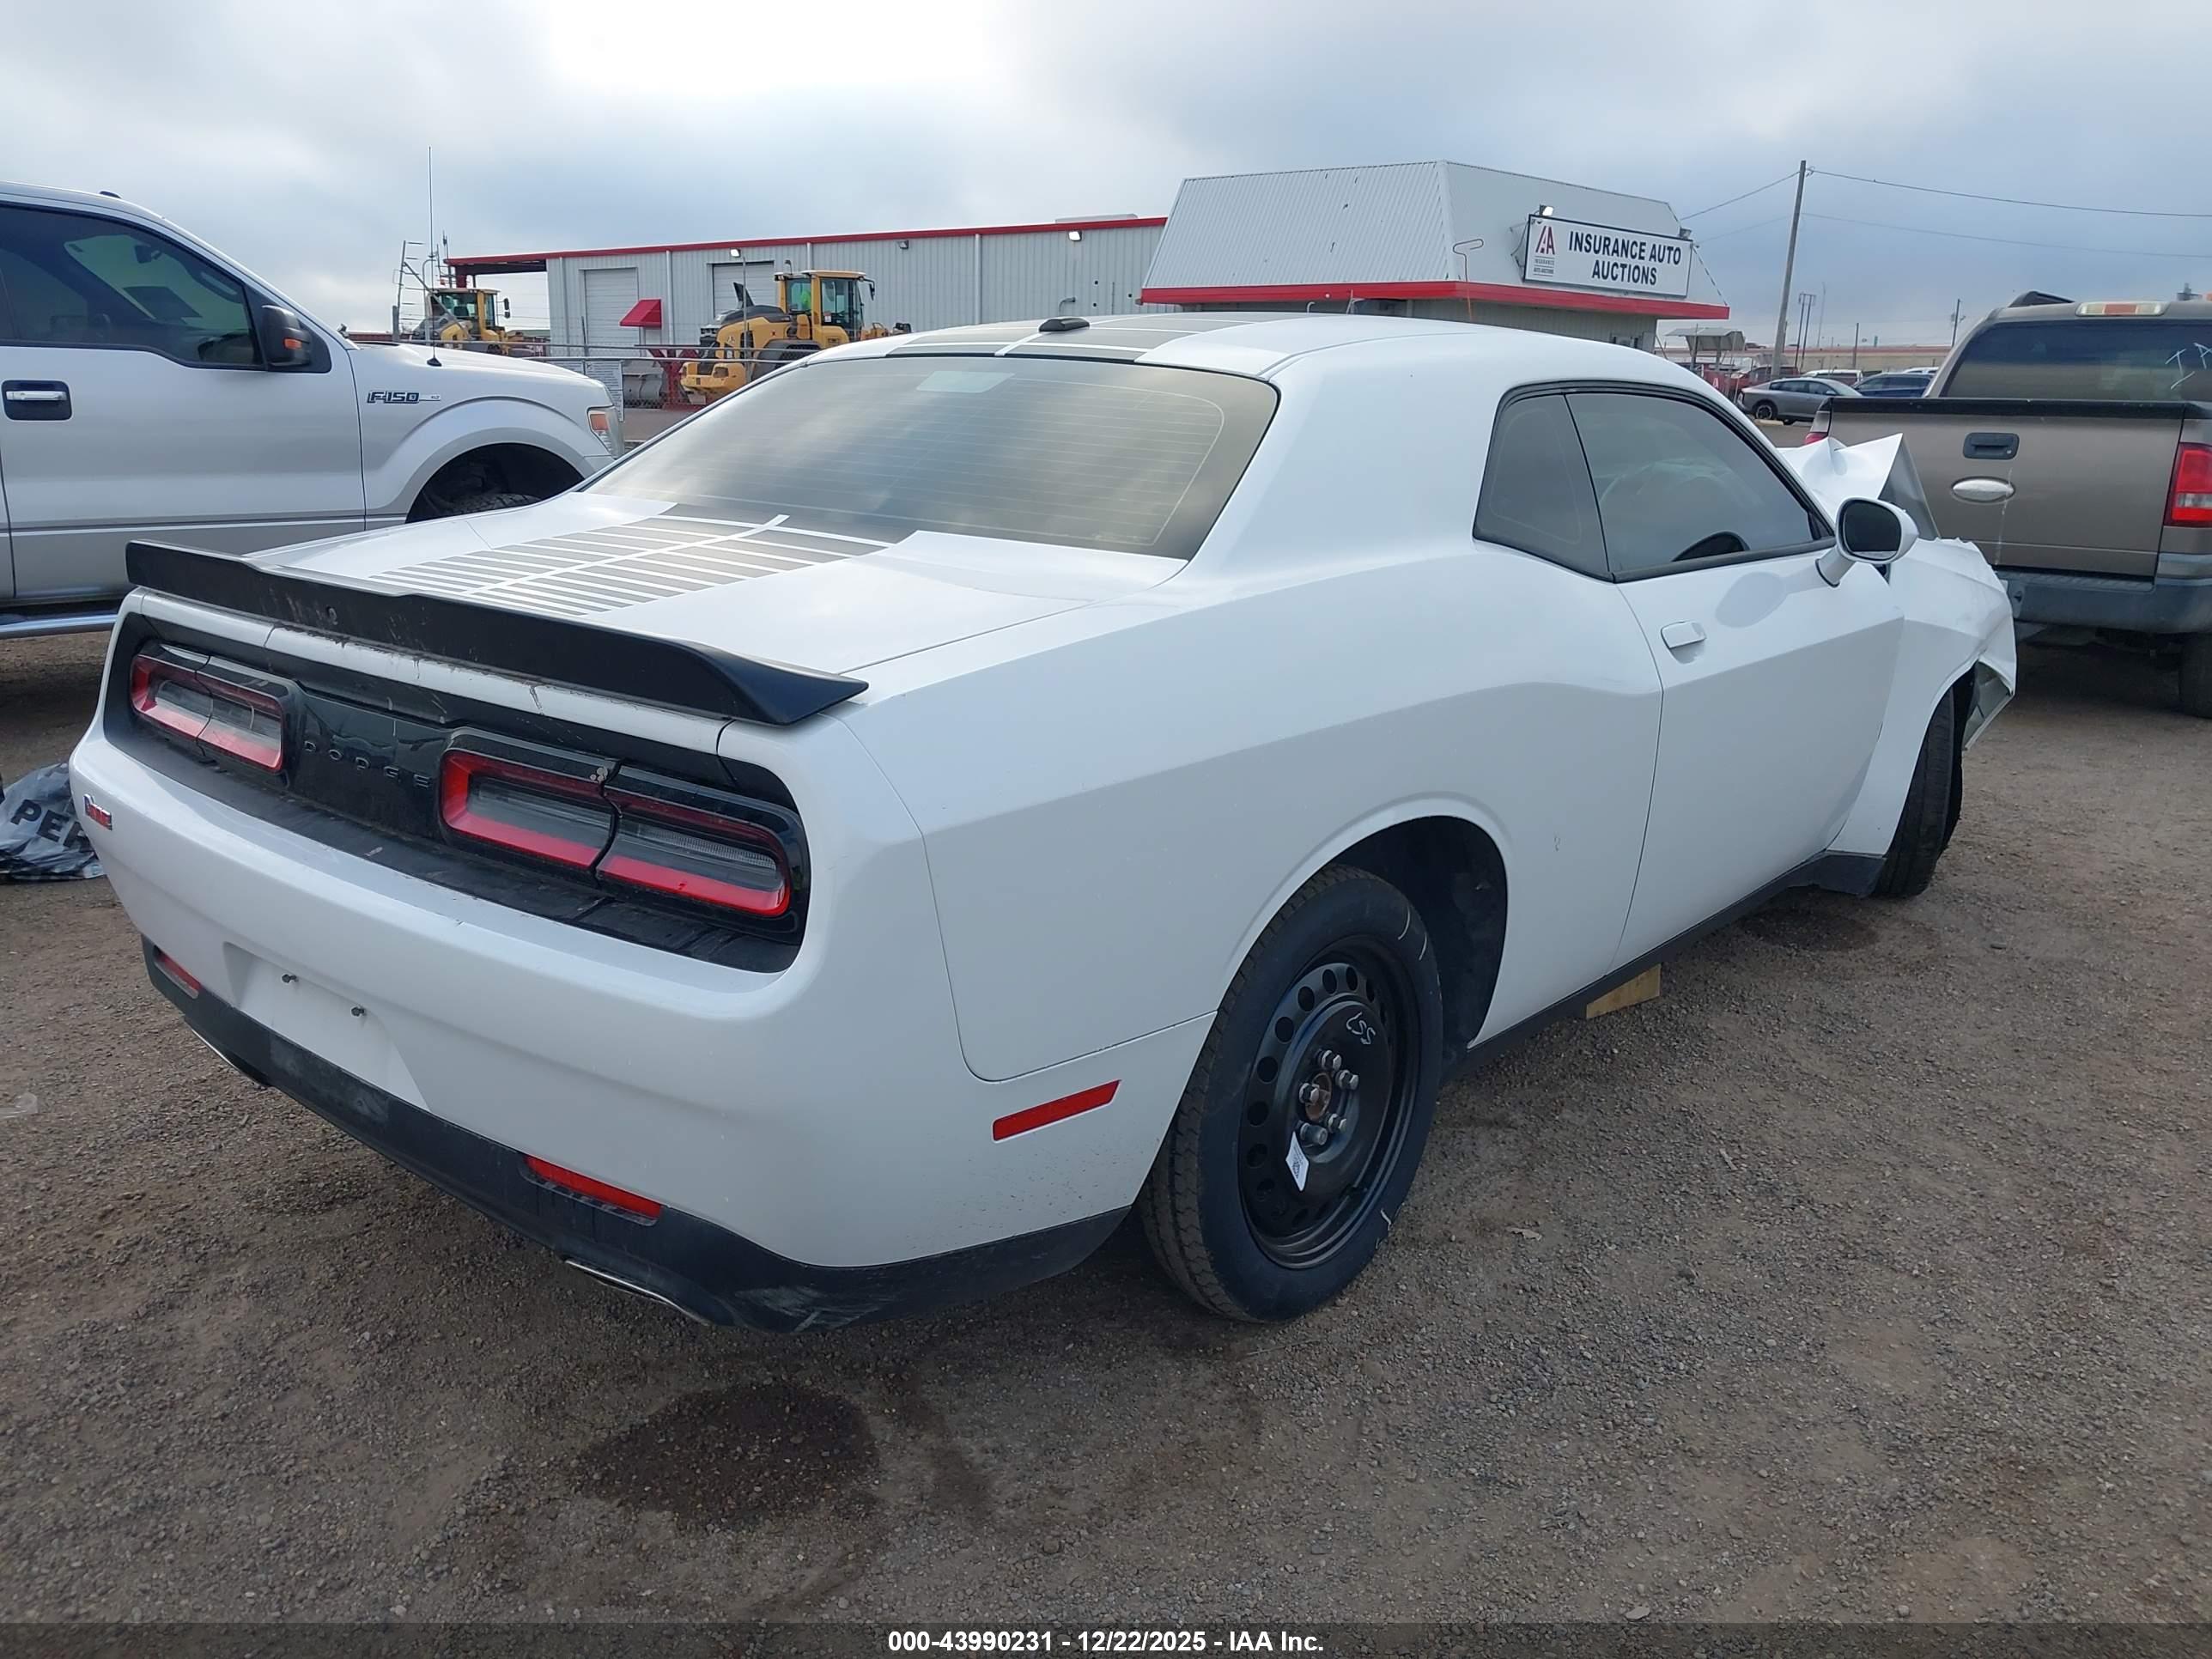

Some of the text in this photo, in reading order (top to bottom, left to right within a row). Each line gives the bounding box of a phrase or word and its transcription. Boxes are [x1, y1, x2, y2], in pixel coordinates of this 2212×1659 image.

[1569, 231, 1681, 265] INSURANCE AUTO
[1592, 259, 1657, 285] AUCTIONS
[367, 391, 420, 404] F-150
[304, 740, 429, 788] DODGE
